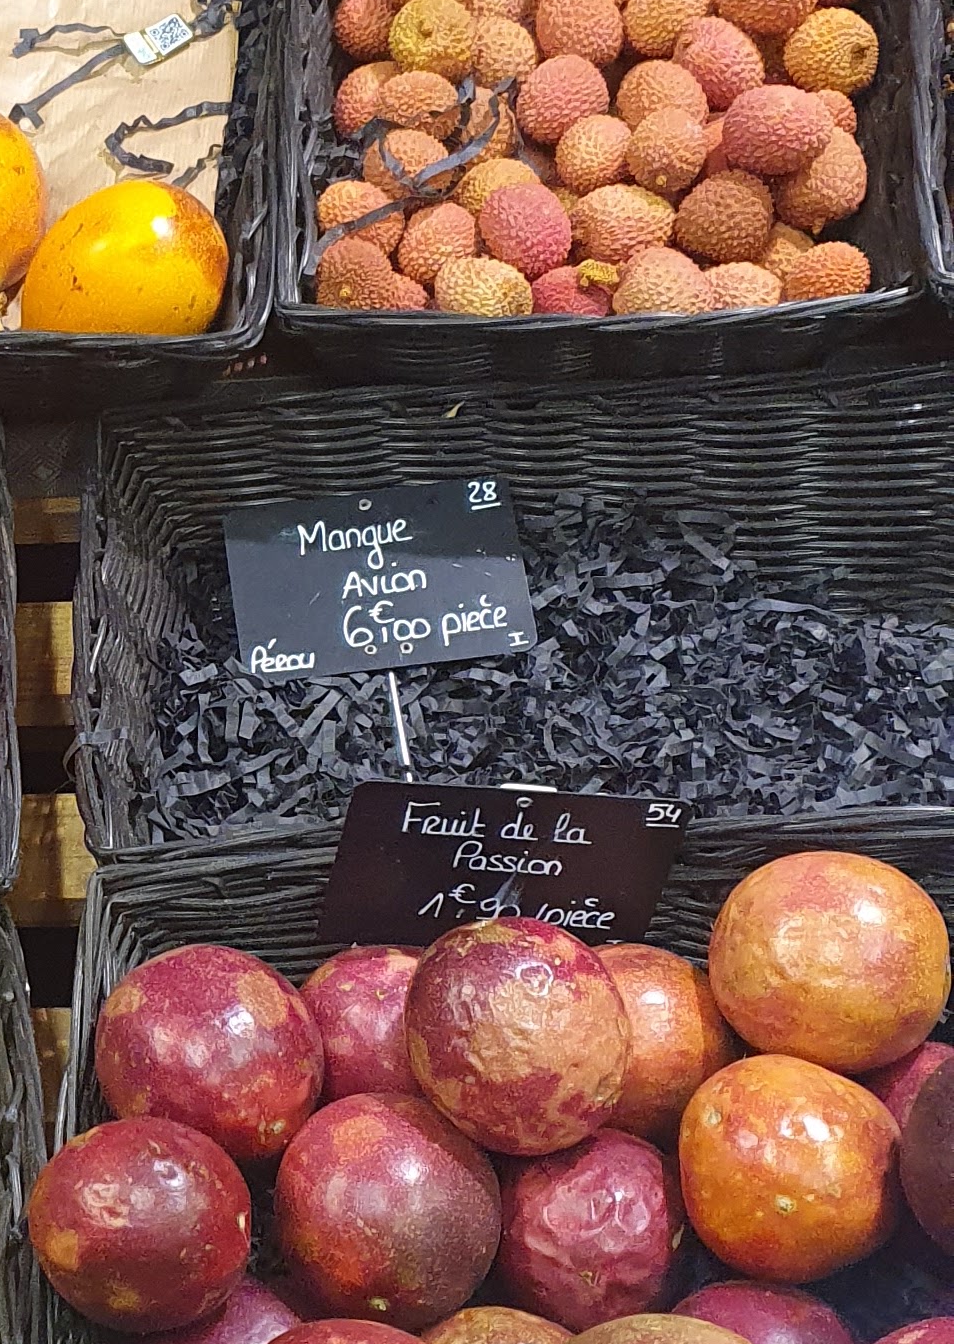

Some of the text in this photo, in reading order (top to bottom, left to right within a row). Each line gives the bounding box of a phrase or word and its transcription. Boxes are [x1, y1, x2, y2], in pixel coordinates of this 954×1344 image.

[467, 481, 498, 504] 28
[297, 518, 414, 570] Mangue
[401, 801, 593, 845] Fruit de la
[647, 804, 682, 823] 54
[452, 840, 564, 877] Passion
